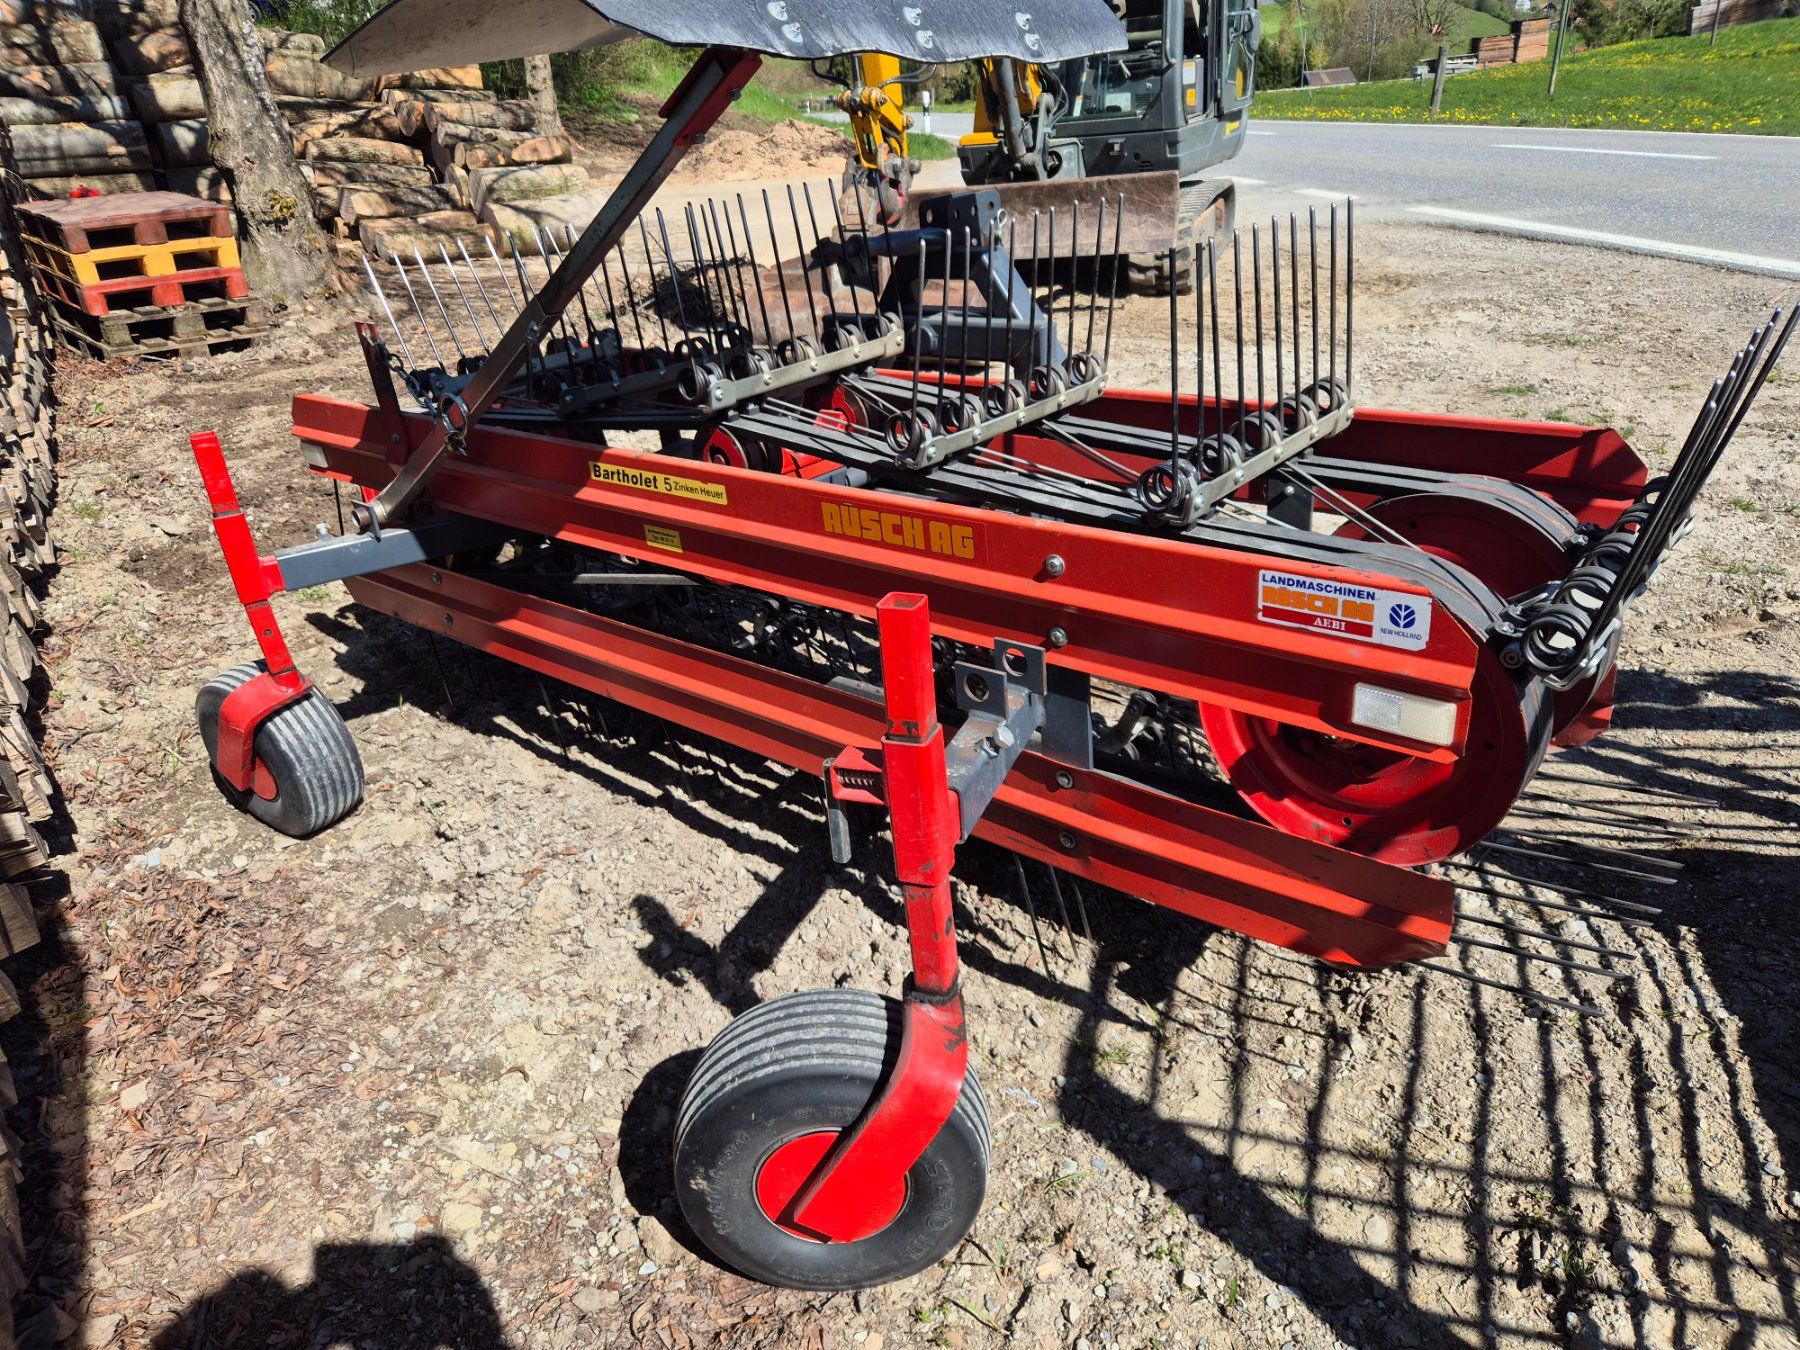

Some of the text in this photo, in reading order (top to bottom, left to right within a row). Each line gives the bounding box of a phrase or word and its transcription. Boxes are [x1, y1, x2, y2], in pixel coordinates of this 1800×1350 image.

[593, 464, 724, 499] Bartholet 5 Zinken Heuer
[821, 502, 975, 559] RÜSCH AG
[1262, 573, 1376, 600] LANDMASCHINEN
[1262, 585, 1374, 622] RÜSCH AG
[1313, 616, 1347, 631] AEBI
[1394, 630, 1422, 640] HOLLAND
